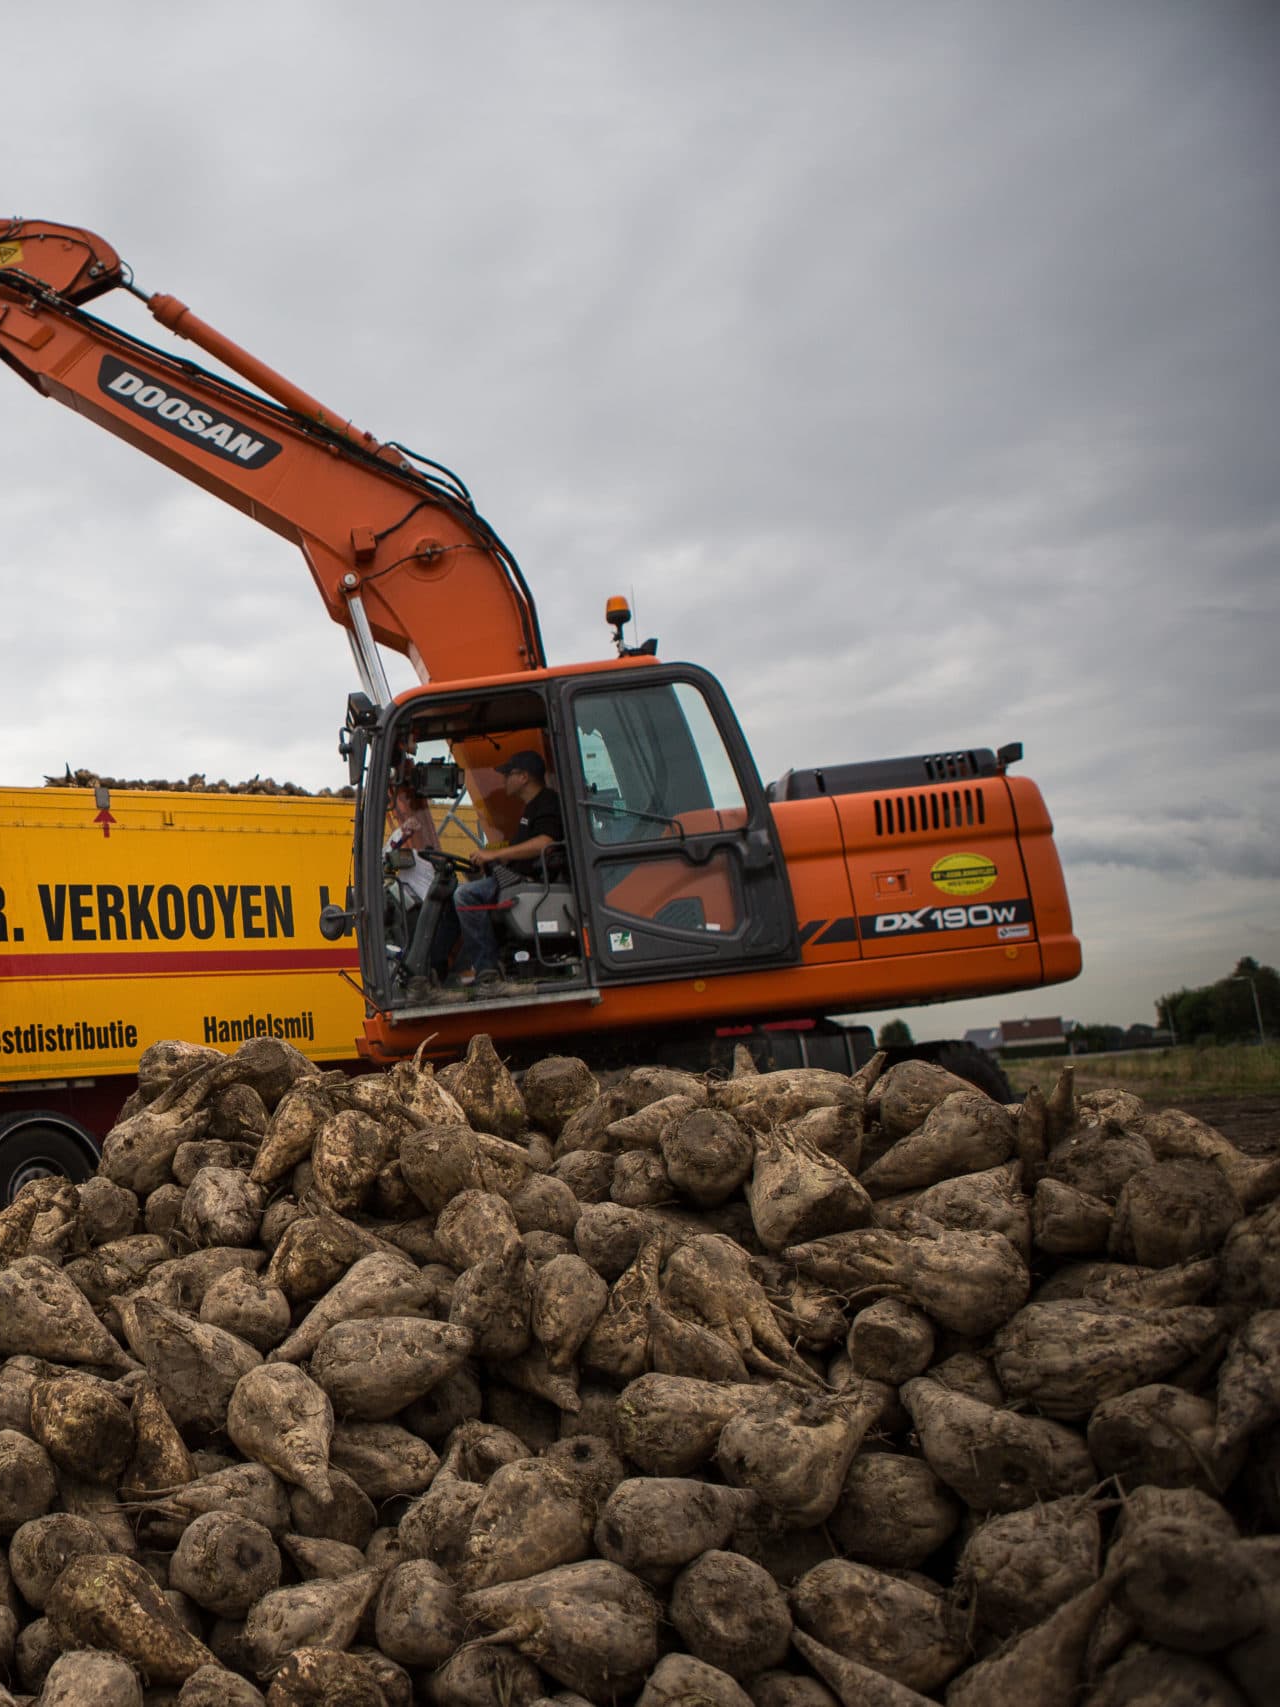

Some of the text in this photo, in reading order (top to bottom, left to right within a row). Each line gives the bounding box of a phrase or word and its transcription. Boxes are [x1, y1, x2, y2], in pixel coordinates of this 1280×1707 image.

[108, 371, 264, 460] DOOSAN
[37, 884, 295, 941] VERKOOYEN
[204, 1011, 314, 1043] Handelsmij
